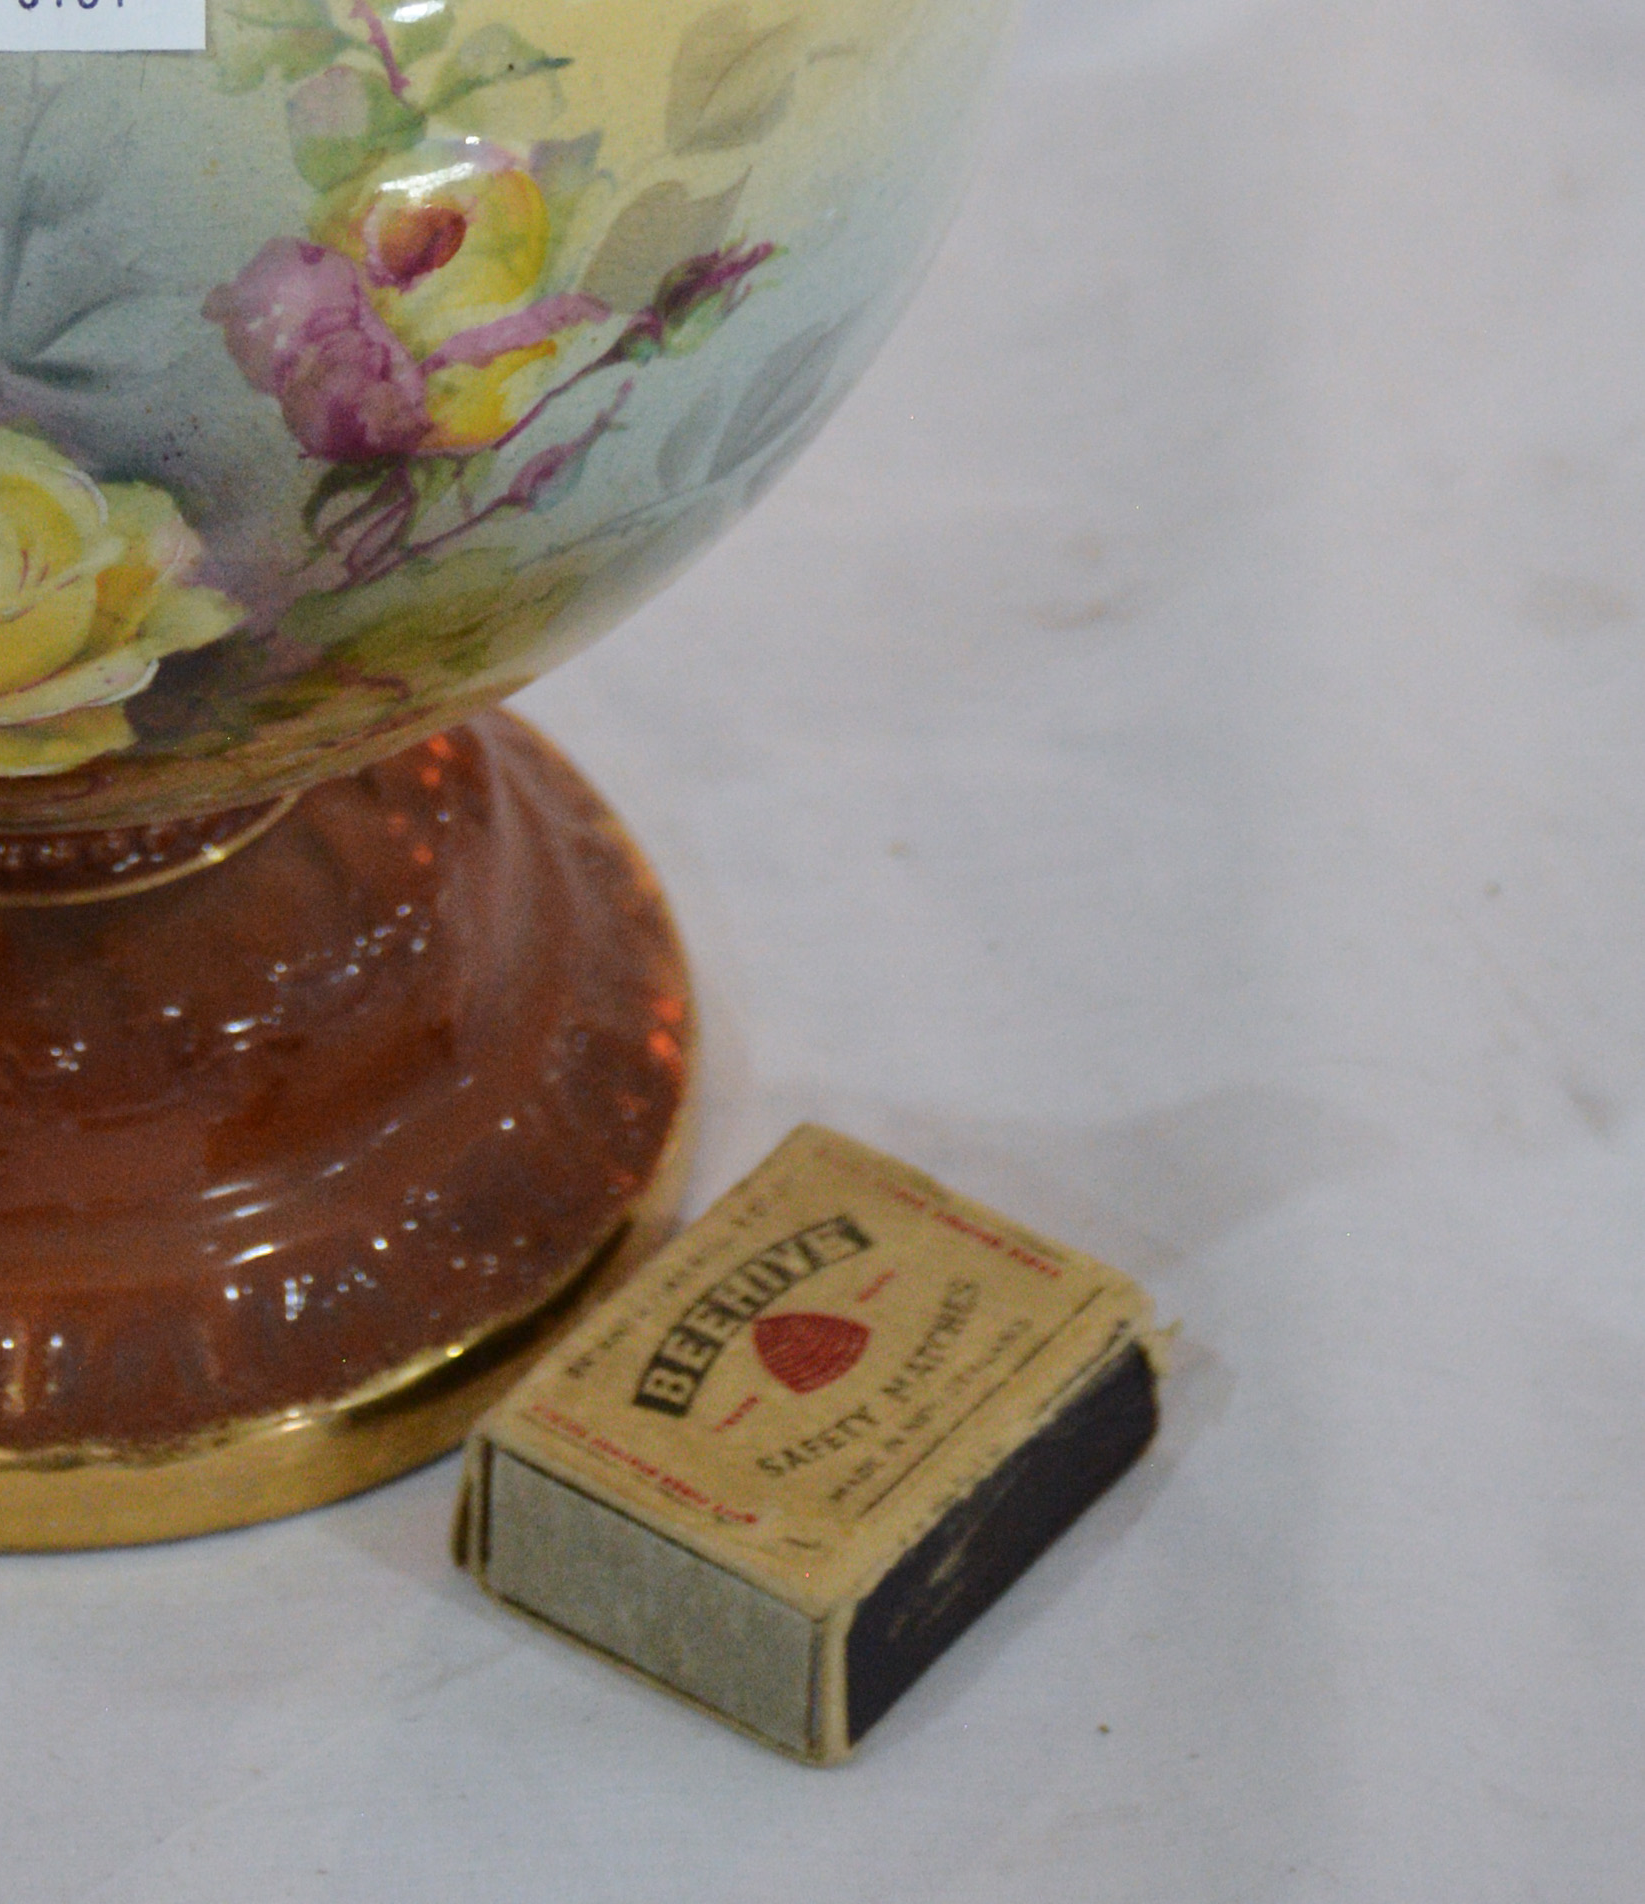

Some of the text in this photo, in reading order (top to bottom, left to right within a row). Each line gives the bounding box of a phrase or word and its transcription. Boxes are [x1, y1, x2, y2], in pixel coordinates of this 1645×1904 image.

[636, 1217, 866, 1406] BEEHIVE
[756, 1406, 880, 1476] SAFETY
[880, 1278, 981, 1404] MATCHES
